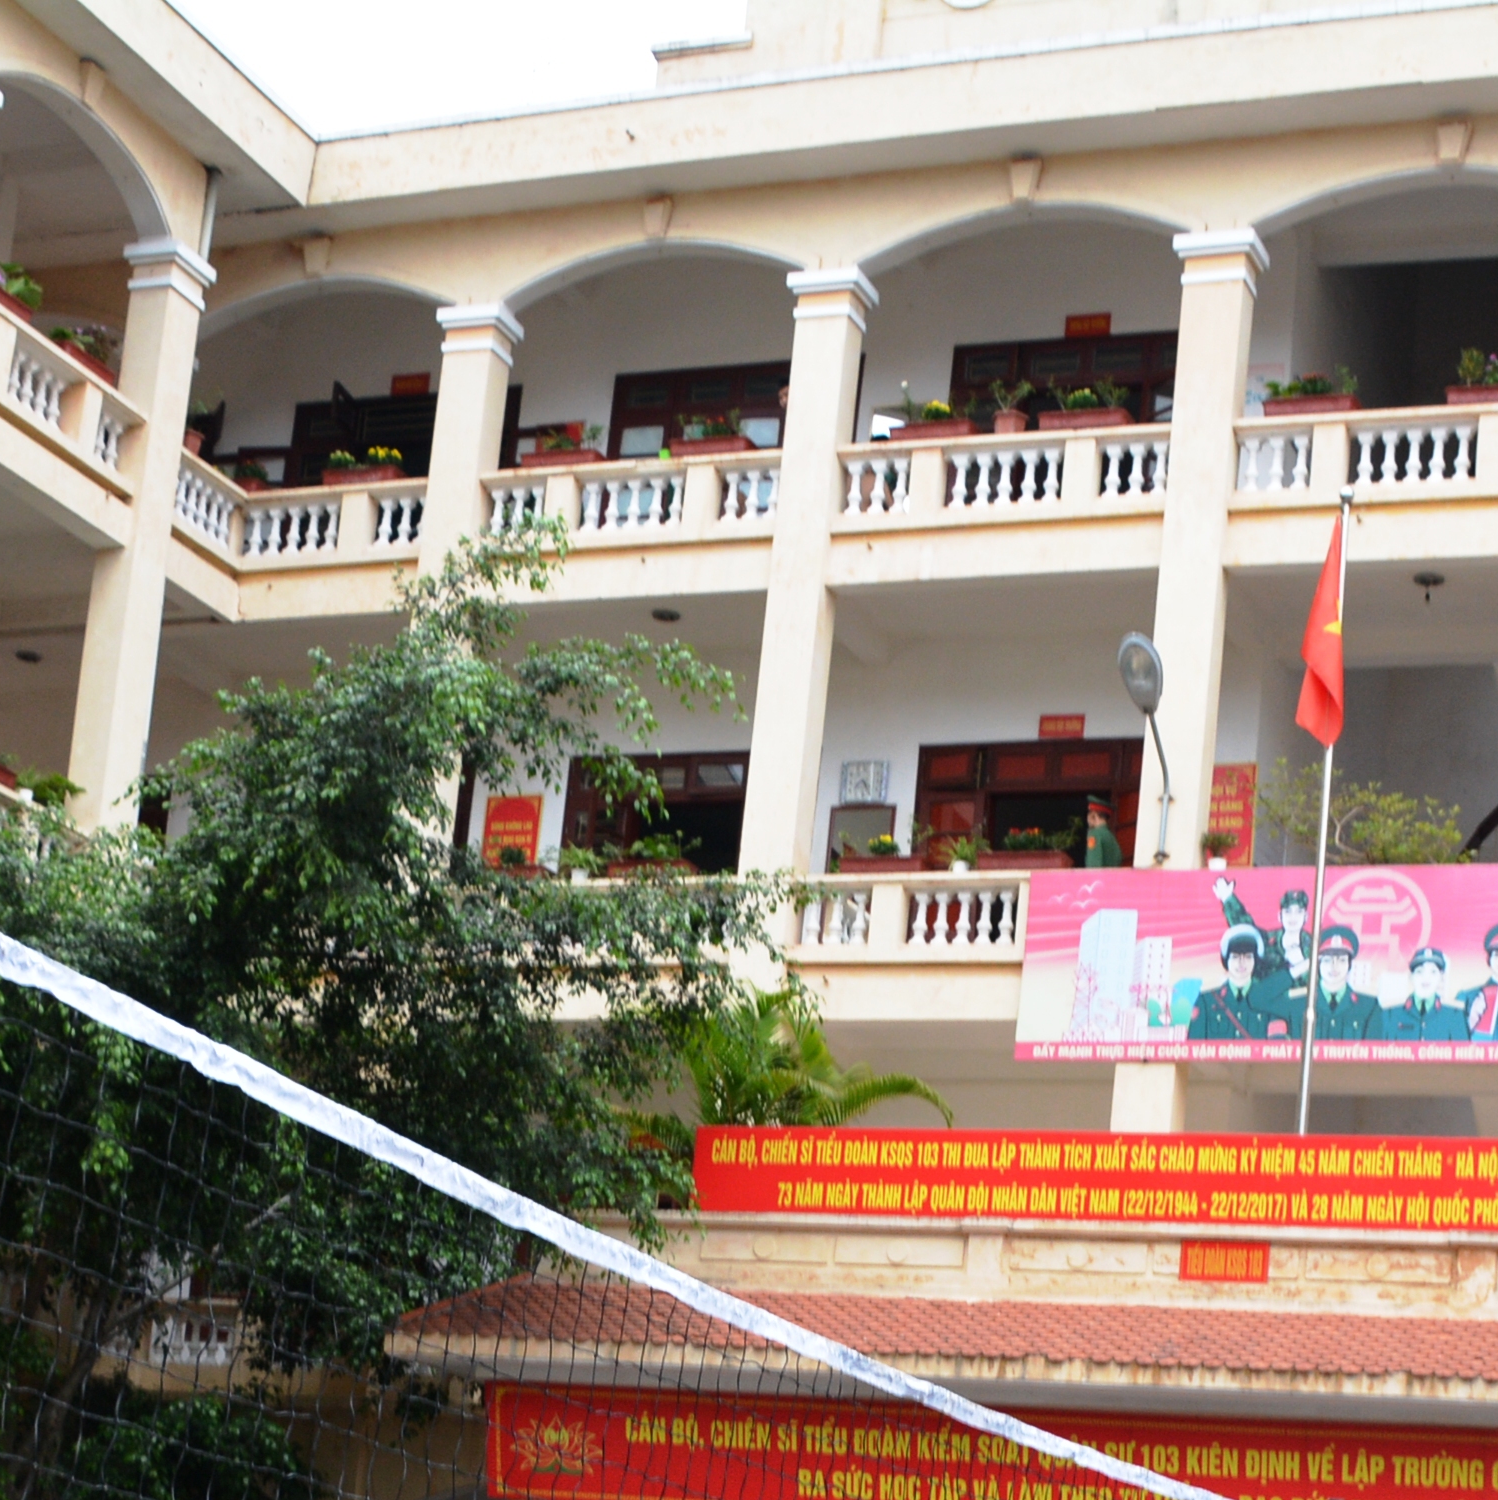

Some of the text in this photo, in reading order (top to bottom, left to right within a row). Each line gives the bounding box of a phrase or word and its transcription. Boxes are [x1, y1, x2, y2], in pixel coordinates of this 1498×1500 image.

[711, 1134, 737, 1164] CÁN
[739, 1134, 758, 1170] BỘ,
[761, 1131, 798, 1166] CHIẾN
[800, 1135, 815, 1166] SĨ
[816, 1130, 841, 1167] TIỂU
[844, 1135, 878, 1168] ĐOÀN
[880, 1141, 914, 1170] KSQS
[917, 1140, 939, 1168] 103
[942, 1141, 961, 1168] THI
[963, 1142, 989, 1169] ĐUA
[992, 1138, 1016, 1175] LẬP
[1019, 1138, 1060, 1170] THÀNH
[1063, 1139, 1092, 1171] TÍCH
[1094, 1135, 1128, 1171] XUẤT
[1130, 1135, 1157, 1172] SẮC
[1159, 1140, 1195, 1173] CHÀO
[1197, 1140, 1237, 1174] MỪNG
[1240, 1136, 1259, 1174] KỶ
[1260, 1142, 1295, 1181] NIỆM
[1298, 1149, 1315, 1176] 45
[1318, 1144, 1350, 1177] NĂM
[1353, 1141, 1394, 1178] CHIẾN
[1398, 1142, 1442, 1179] THẮNG
[1456, 1146, 1474, 1179] HÀ
[778, 1181, 792, 1206] 73
[795, 1178, 824, 1208] NĂM
[826, 1178, 861, 1209] NGÀY
[862, 1179, 902, 1210] THÀNH
[904, 1179, 927, 1215] LẬP
[930, 1180, 965, 1212] QUÂN
[968, 1181, 989, 1216] ĐỘI
[991, 1181, 1028, 1213] NHÂN
[1030, 1182, 1056, 1213] DÂN
[1060, 1182, 1087, 1219] VIỆT
[1089, 1188, 1120, 1216] NAM
[1291, 1189, 1308, 1221] VÀ
[1312, 1194, 1328, 1221] 28
[1331, 1190, 1364, 1222] NĂM
[1366, 1190, 1403, 1223] NGÀY
[1406, 1191, 1429, 1230] HỘI
[1433, 1188, 1470, 1227] QUỐC
[626, 1411, 666, 1444] CÁN
[710, 1415, 771, 1451] CHIẾN
[803, 1415, 848, 1455] TIỂU
[853, 1424, 911, 1459] ĐOÀN
[918, 1422, 971, 1462] KIỂM
[1141, 1443, 1180, 1473] 103
[1186, 1440, 1239, 1478] KIÊN
[1245, 1448, 1300, 1486] ĐỊNH
[1307, 1442, 1335, 1483] VỀ
[1341, 1448, 1385, 1491] LẬP
[1392, 1449, 1485, 1490] TRƯỜNG
[798, 1467, 827, 1498] RA
[832, 1464, 874, 1500] SỨC
